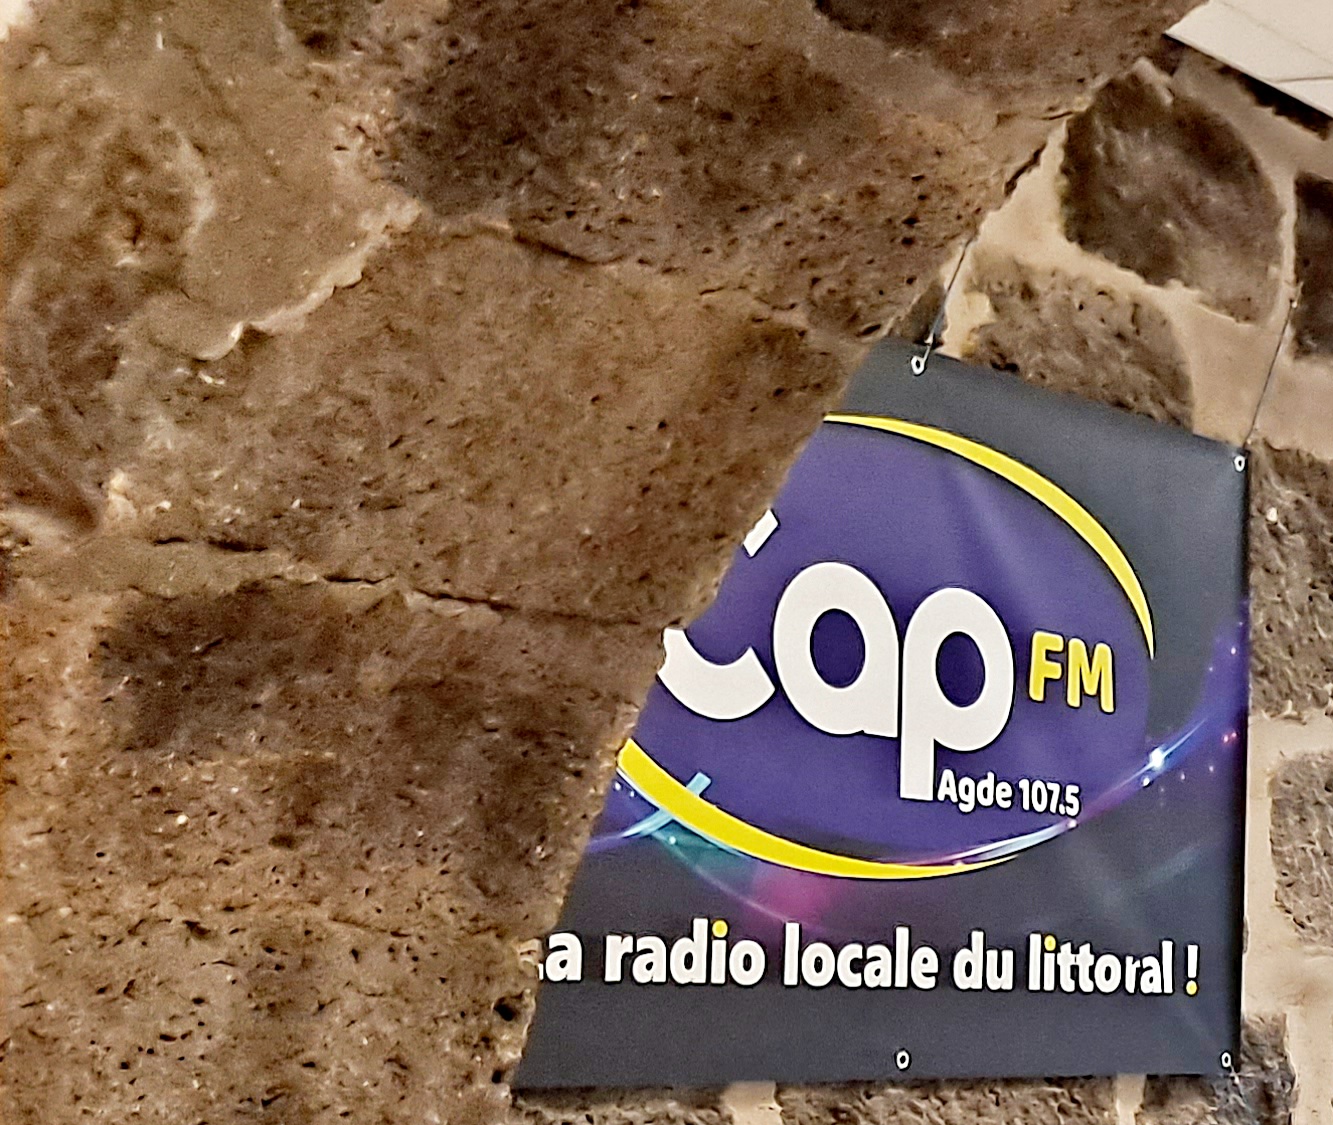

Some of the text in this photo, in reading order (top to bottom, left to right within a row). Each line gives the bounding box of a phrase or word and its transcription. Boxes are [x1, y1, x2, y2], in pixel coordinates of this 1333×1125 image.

[1028, 630, 1115, 713] FM
[937, 768, 1081, 817] Agde 107.5
[537, 918, 1200, 995] a radio locale du littoral !
